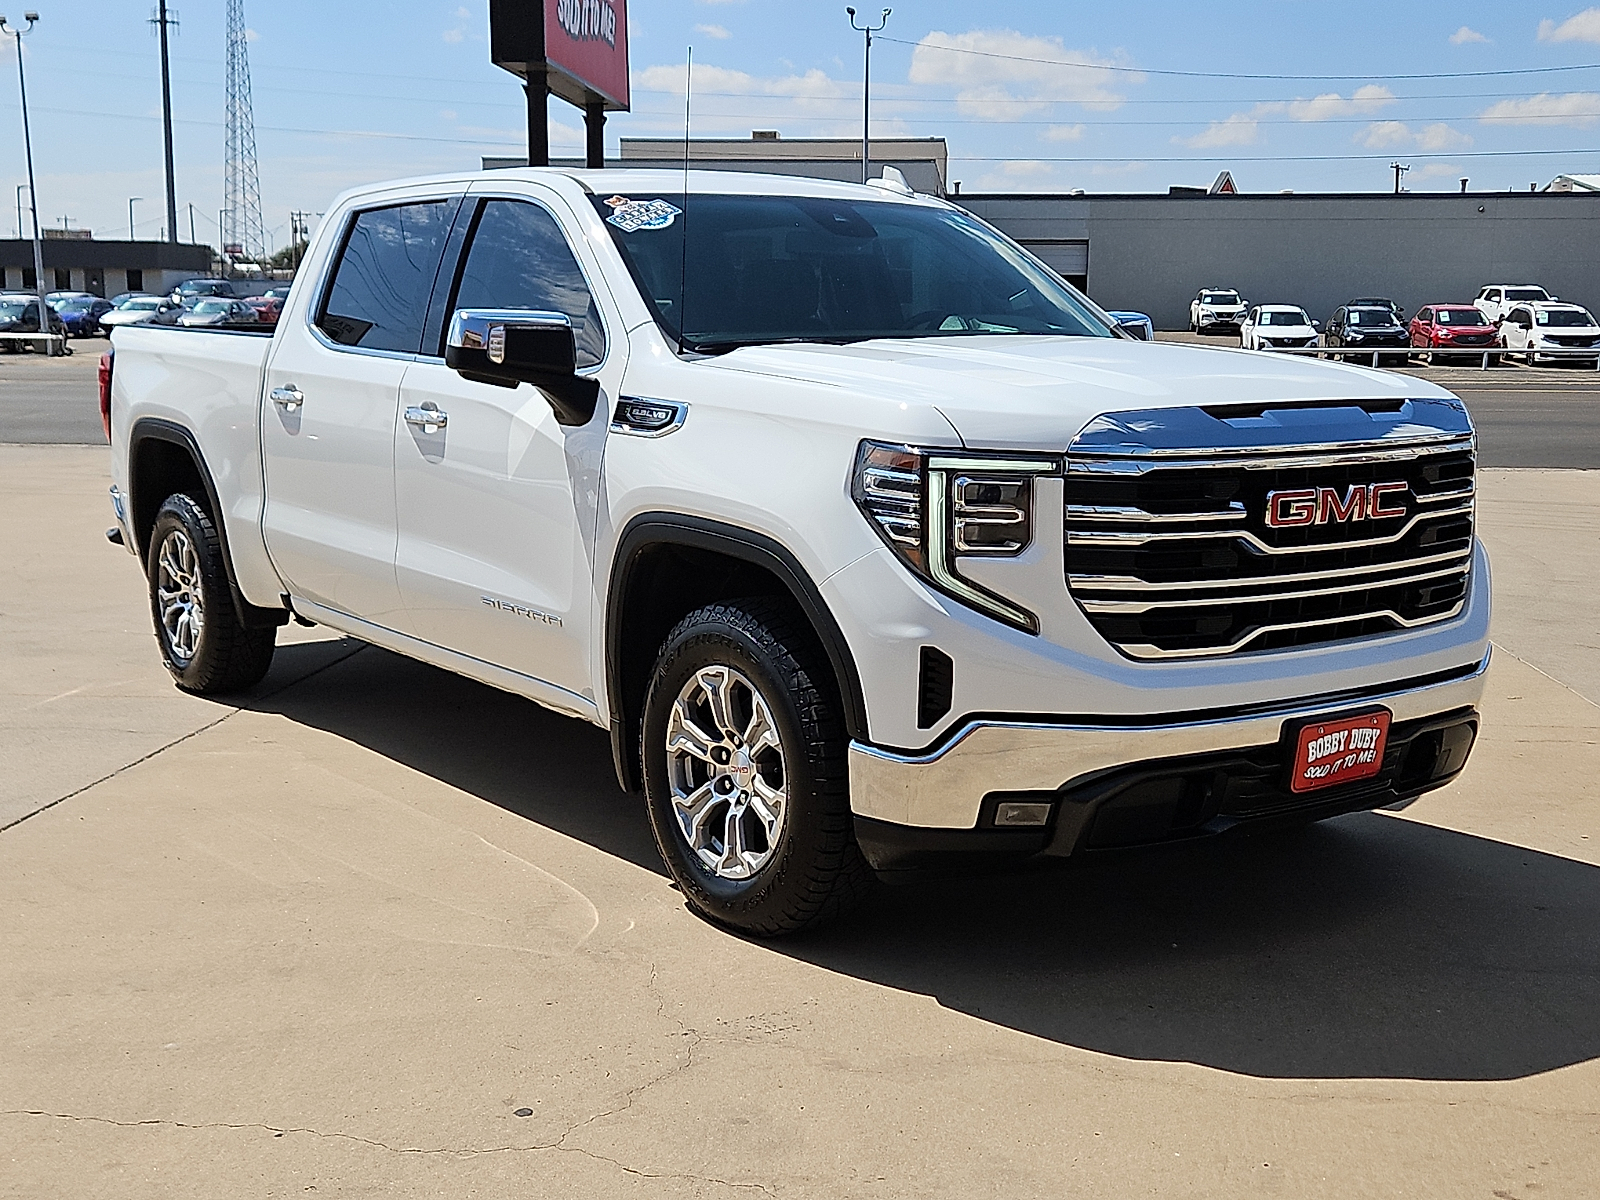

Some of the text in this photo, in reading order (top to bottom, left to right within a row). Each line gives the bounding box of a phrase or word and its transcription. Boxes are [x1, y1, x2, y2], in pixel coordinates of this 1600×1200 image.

[1265, 481, 1408, 528] GMC
[481, 595, 563, 627] SIERRA
[1307, 728, 1381, 763] BOBBY DUBY
[1304, 750, 1377, 779] SOLD IT TO ME!
